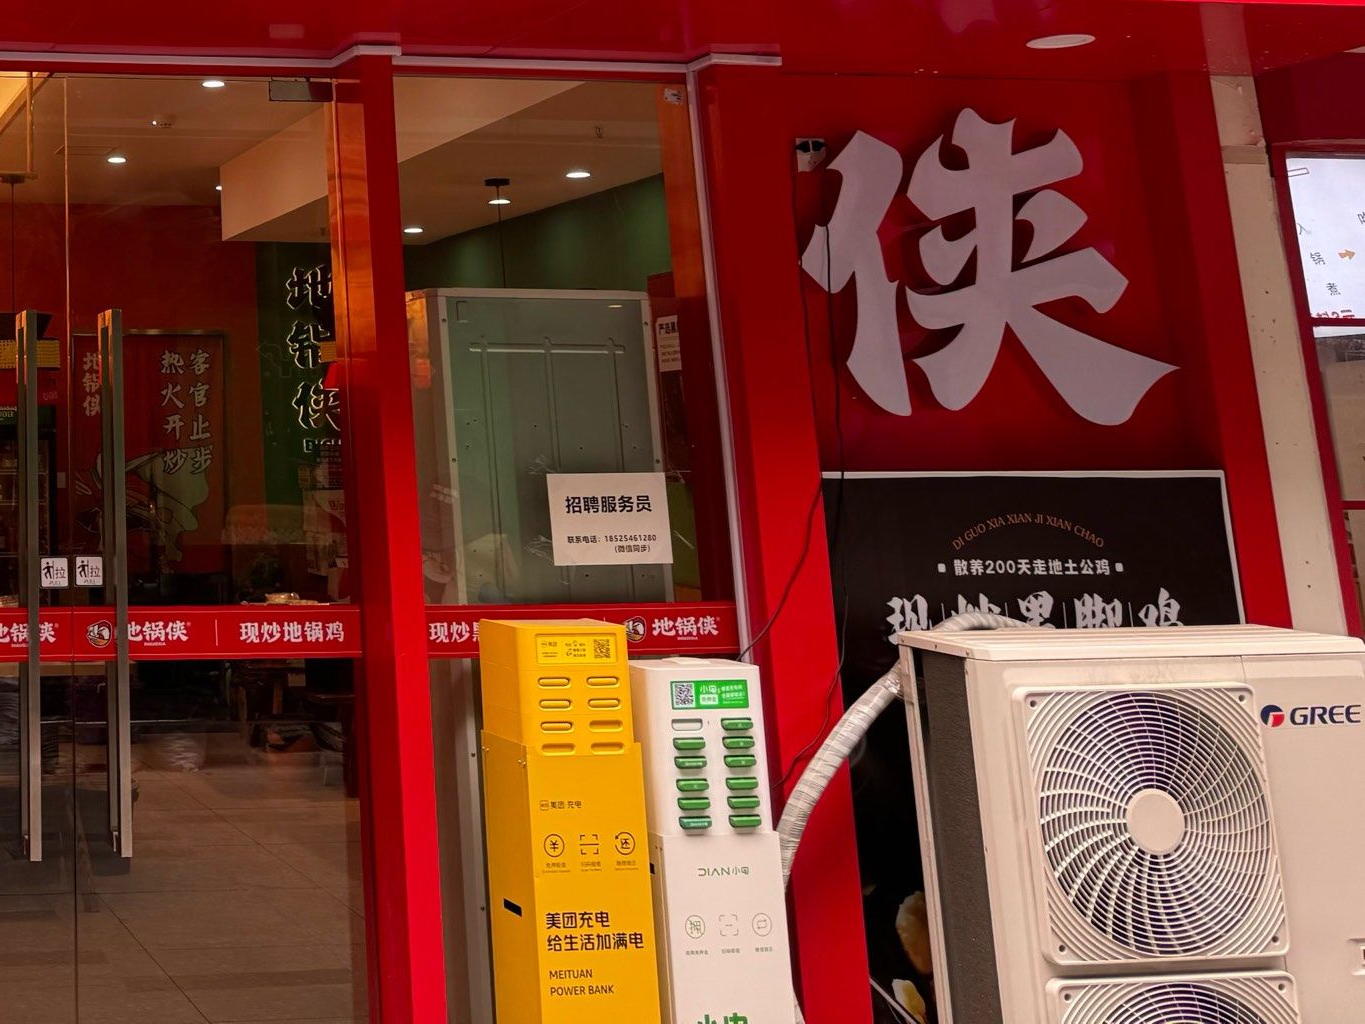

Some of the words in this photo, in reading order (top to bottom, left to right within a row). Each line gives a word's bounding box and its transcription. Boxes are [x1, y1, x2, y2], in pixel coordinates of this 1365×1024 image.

[802, 107, 1181, 427] 侠
[160, 350, 187, 474] 热火开炒
[189, 349, 213, 474] 客官止步
[565, 495, 652, 514] 招聘服务员
[952, 537, 965, 551] DI
[964, 523, 986, 541] GUO
[986, 516, 1006, 531] XIA
[1006, 512, 1032, 524] XIAN
[1034, 513, 1044, 524] JI
[1045, 515, 1072, 532] XIAN
[1073, 524, 1105, 548] CHAO
[55, 566, 66, 579] 拉
[90, 566, 101, 577] 拉
[953, 558, 1111, 576] 散养200天走地土公鸡
[239, 620, 344, 644] 现炒地锅鸡
[651, 616, 718, 637] 地锅侠
[1289, 704, 1362, 727] GREE
[545, 911, 610, 930] 美团充电
[547, 932, 644, 952] 给生活加满电
[549, 969, 593, 980] MEITUAN
[550, 985, 586, 996] POWER
[588, 984, 614, 995] BANK
